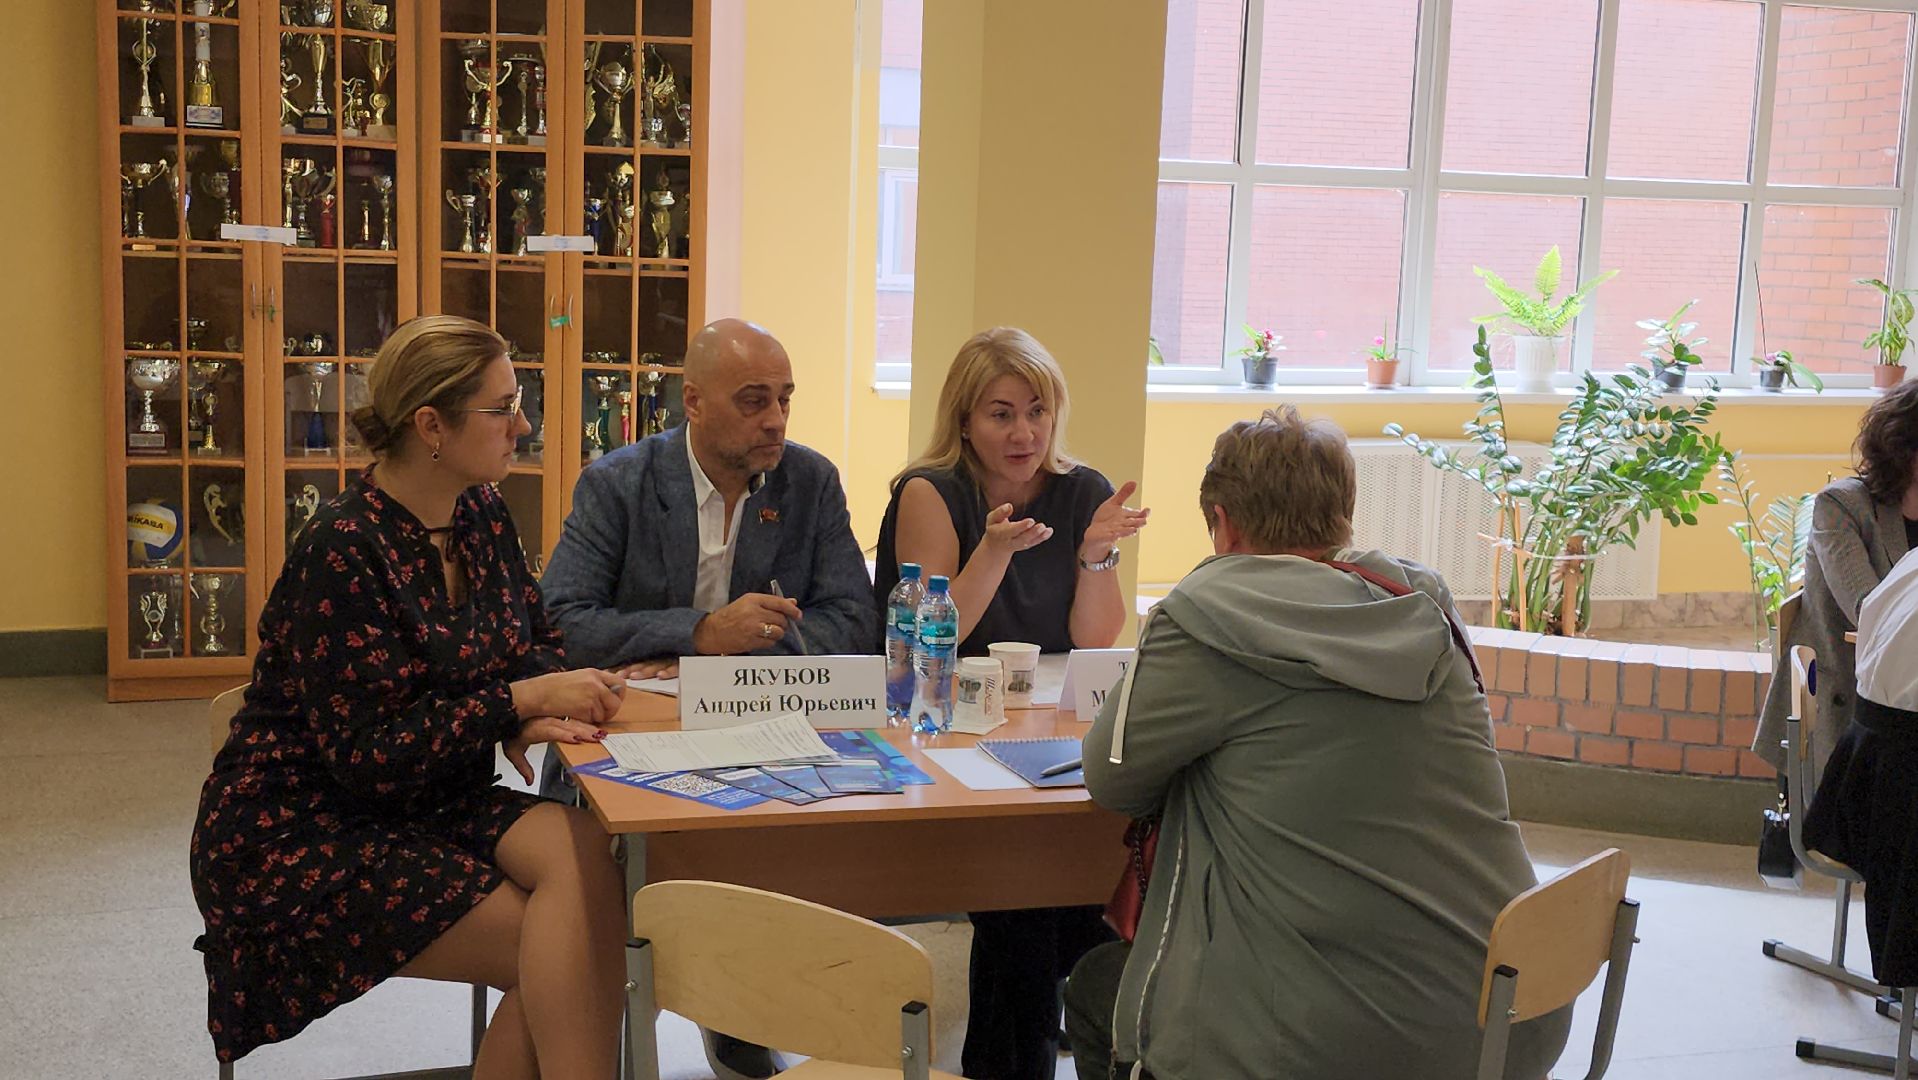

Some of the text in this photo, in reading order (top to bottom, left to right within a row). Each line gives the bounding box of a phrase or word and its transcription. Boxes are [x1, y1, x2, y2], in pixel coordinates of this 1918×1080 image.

[733, 667, 831, 687] ЯКУБОВ
[694, 694, 877, 717] Андрей Юрьевич
